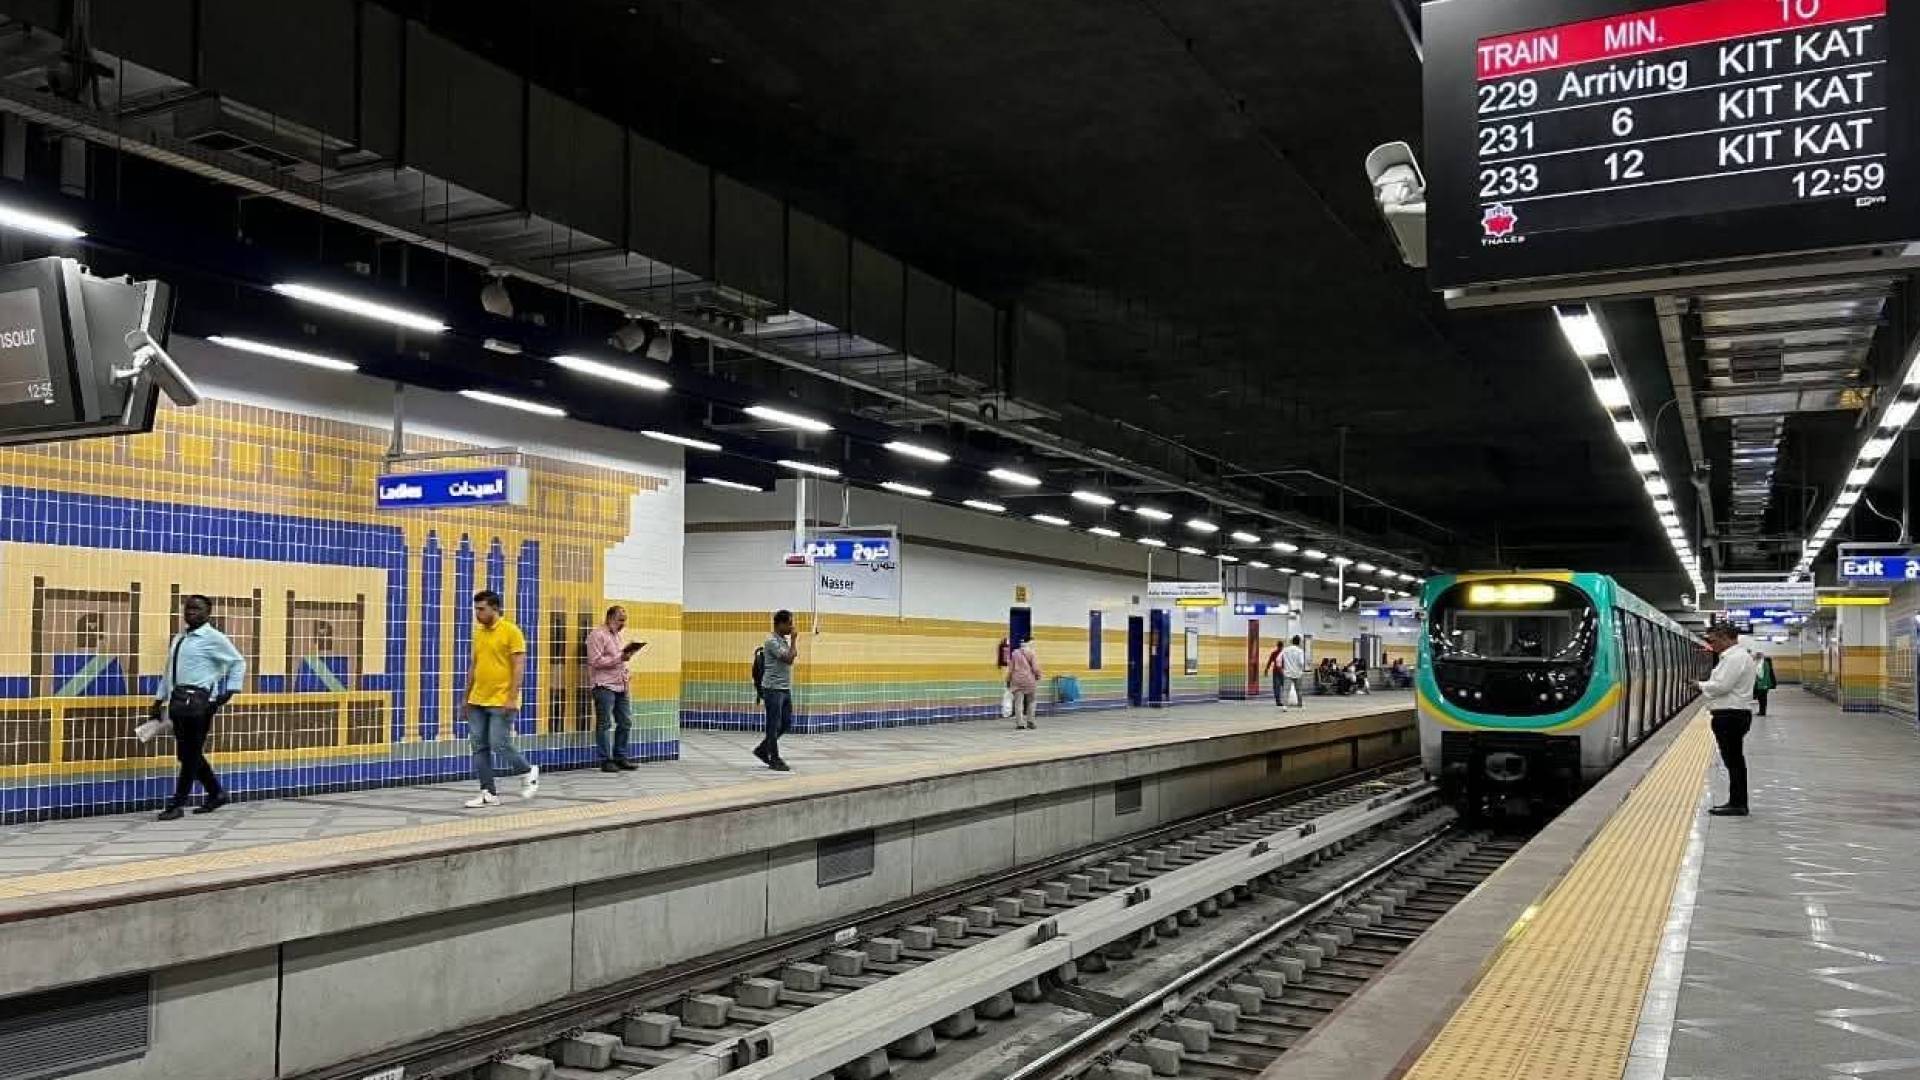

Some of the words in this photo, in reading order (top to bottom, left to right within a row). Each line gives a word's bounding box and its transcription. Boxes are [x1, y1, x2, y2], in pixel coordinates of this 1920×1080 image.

[1478, 78, 1538, 114] 229
[1557, 59, 1688, 101] Arriving
[1719, 38, 1782, 77] KIT
[1795, 24, 1873, 66] KAT
[1479, 34, 1559, 71] TRAIN
[1604, 20, 1664, 51] MIN.
[1478, 121, 1535, 156] 231
[1611, 106, 1634, 137] 6
[1719, 84, 1783, 122] KIT
[1794, 72, 1873, 111] KAT
[1479, 163, 1540, 198] 233
[1604, 149, 1645, 181] 12
[1718, 129, 1782, 167] KIT
[1794, 118, 1873, 157] KAT
[1792, 163, 1885, 198] 12:59
[821, 576, 854, 590] Nasser
[1843, 560, 1884, 576] Exit
